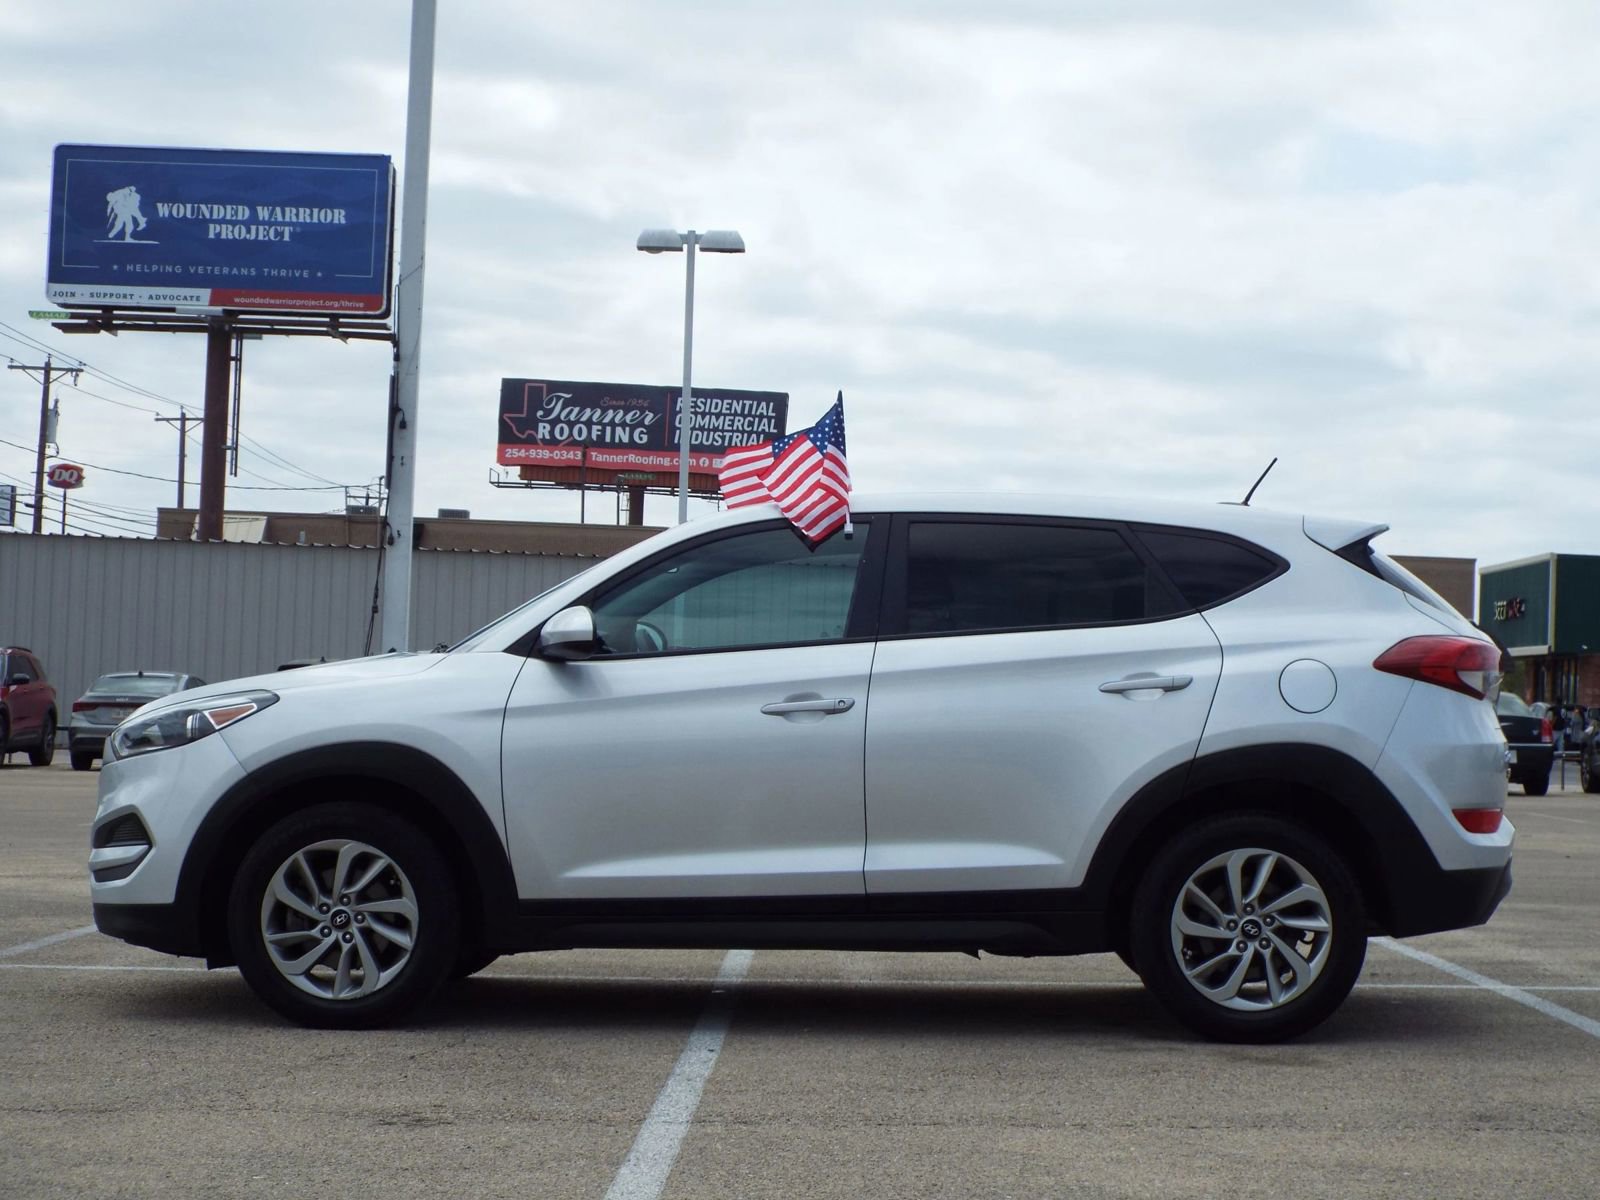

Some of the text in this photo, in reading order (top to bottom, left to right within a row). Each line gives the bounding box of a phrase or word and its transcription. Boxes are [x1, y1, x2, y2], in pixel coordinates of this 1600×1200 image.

[156, 202, 347, 224] WOUNDED WARRIOR
[207, 223, 293, 242] PROJECT
[126, 264, 310, 278] HELPING VETERANS THRIVE
[52, 290, 202, 302] JOIN SUPPORT ADVOCATE
[233, 296, 365, 308] woundedwarriorproject.org/thrive
[536, 392, 662, 426] Tanner
[675, 397, 776, 417] RESIDENTIAL
[537, 422, 649, 444] ROOFING
[673, 429, 765, 447] IDUSTRIA
[505, 448, 582, 460] 254-939-0343
[590, 451, 697, 467] TannerRoofing.cm
[53, 468, 79, 484] DQ
